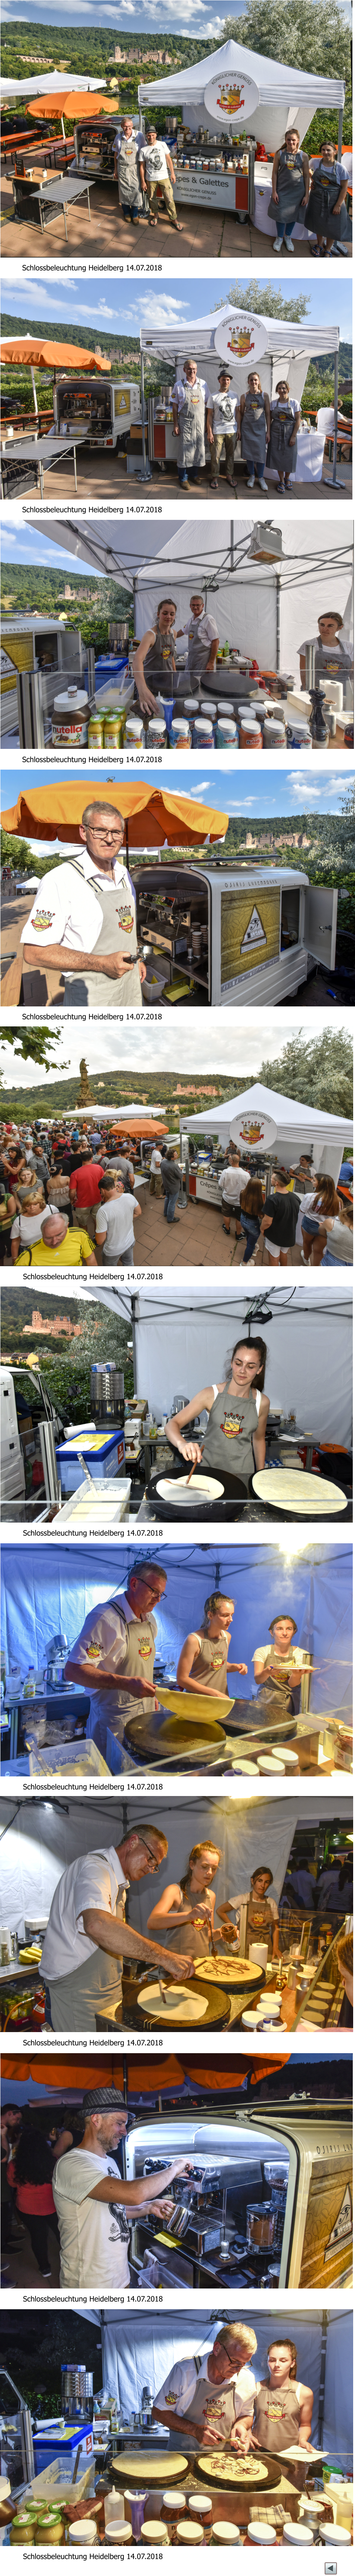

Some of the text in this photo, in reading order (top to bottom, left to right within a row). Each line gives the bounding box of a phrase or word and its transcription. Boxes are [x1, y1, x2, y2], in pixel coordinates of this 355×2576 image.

[211, 73, 252, 85] KÖNIGLICHER GENUSS
[169, 174, 189, 182] êpes
[200, 178, 229, 187] Galettes
[222, 316, 261, 328] KÖNIGLICHER GENUSS
[53, 725, 82, 733] nutella
[242, 944, 254, 952] RESURRECT
[236, 1112, 271, 1123] KÖNIGLICHER GENUSS
[200, 1181, 217, 1189] Crêpes
[317, 2145, 339, 2154] OSIRIS
